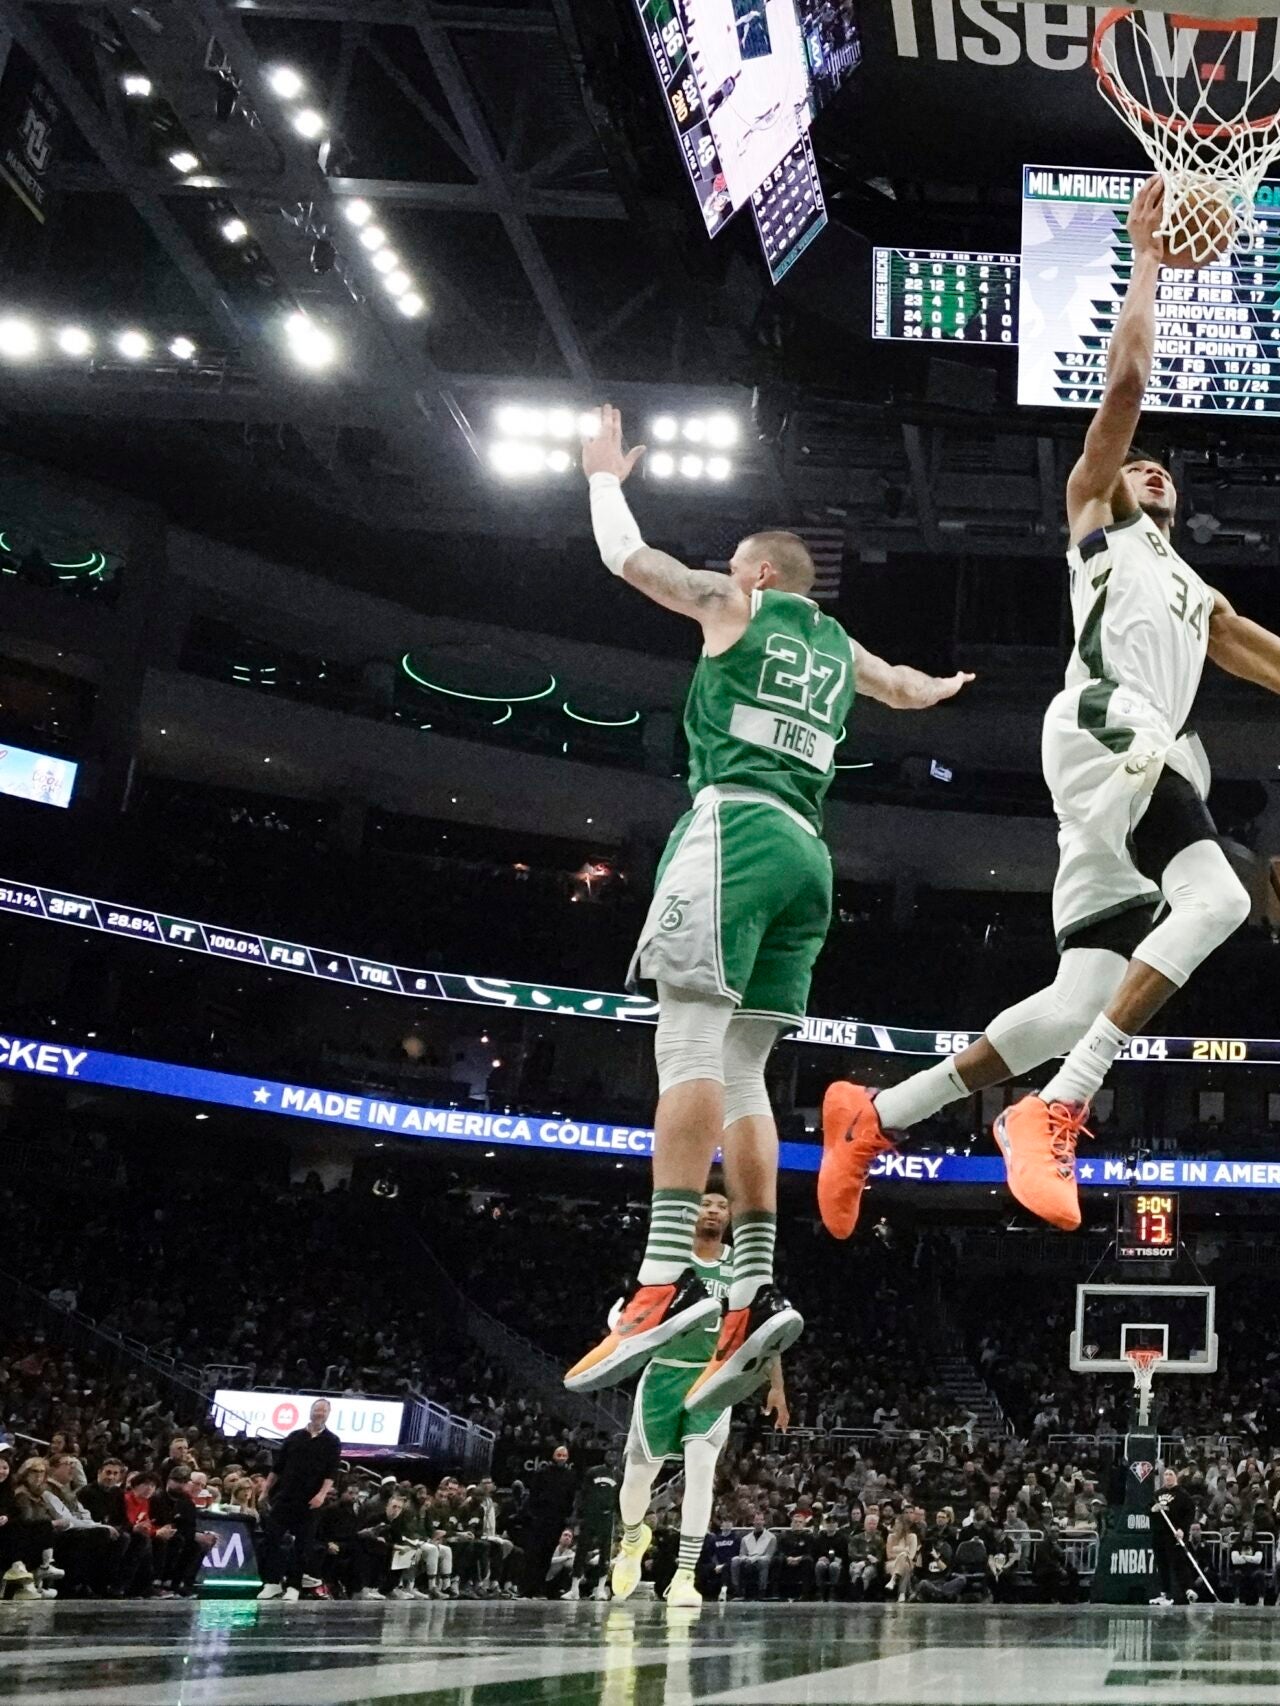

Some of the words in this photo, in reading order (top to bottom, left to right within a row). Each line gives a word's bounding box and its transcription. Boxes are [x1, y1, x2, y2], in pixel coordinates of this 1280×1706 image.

[662, 17, 684, 57] 56
[682, 74, 700, 112] 3:04
[671, 90, 688, 123] 2ND
[697, 135, 715, 168] 49
[1029, 172, 1131, 200] MILWAUKEE
[876, 251, 889, 282] BUCKS
[909, 262, 919, 274] 3
[932, 263, 943, 276] 0
[956, 264, 966, 277] 0
[980, 266, 989, 278] 2
[1161, 268, 1194, 282] OFF
[1197, 270, 1233, 284] REB
[1253, 273, 1263, 285] 3
[904, 278, 923, 290] 22
[930, 279, 945, 291] 12
[956, 280, 965, 292] 4
[979, 282, 989, 294] 4
[1160, 287, 1195, 301] DEF
[1197, 288, 1233, 302] REB
[1250, 291, 1265, 302] 17
[875, 282, 888, 336] MILWAUKEE
[904, 294, 923, 306] 23
[931, 295, 942, 307] 4
[904, 310, 922, 322] 24
[932, 311, 942, 323] 0
[955, 312, 965, 324] 2
[1001, 314, 1012, 326] 0
[1153, 304, 1249, 322] URNOVERS
[1272, 310, 1280, 322] 7
[903, 325, 922, 338] 34
[931, 327, 942, 339] 8
[955, 328, 965, 340] 4
[1001, 330, 1012, 342] 0
[1196, 325, 1252, 340] FOULS
[1270, 328, 1280, 340] 4
[1154, 340, 1191, 354] NCH
[1195, 342, 1258, 358] POINTS
[1183, 359, 1205, 373] FG
[1176, 376, 1211, 391] 3PT
[1182, 394, 1204, 408] FT
[757, 632, 847, 724] 27
[773, 718, 817, 759] THEIS
[49, 898, 92, 920] 3PT
[107, 912, 156, 934] 28.6%
[169, 924, 197, 942] FT
[209, 934, 261, 956] 100.0%
[270, 946, 305, 967] FLS
[327, 960, 339, 973] 4
[359, 965, 392, 986] TOL
[415, 978, 427, 990] 6
[797, 1019, 857, 1045] BUCKS
[934, 1033, 969, 1053] 56
[1192, 1040, 1247, 1061] 2ND
[280, 1087, 362, 1121] MADE
[368, 1103, 396, 1127] IN
[402, 1107, 531, 1142] AMERICA
[1104, 1160, 1175, 1182] MADE
[1182, 1163, 1209, 1183] IN
[1136, 1196, 1173, 1214] 3:04
[1140, 1214, 1167, 1244] 13
[1136, 1247, 1175, 1257] TISSOT
[1110, 1549, 1158, 1575] #NBA7
